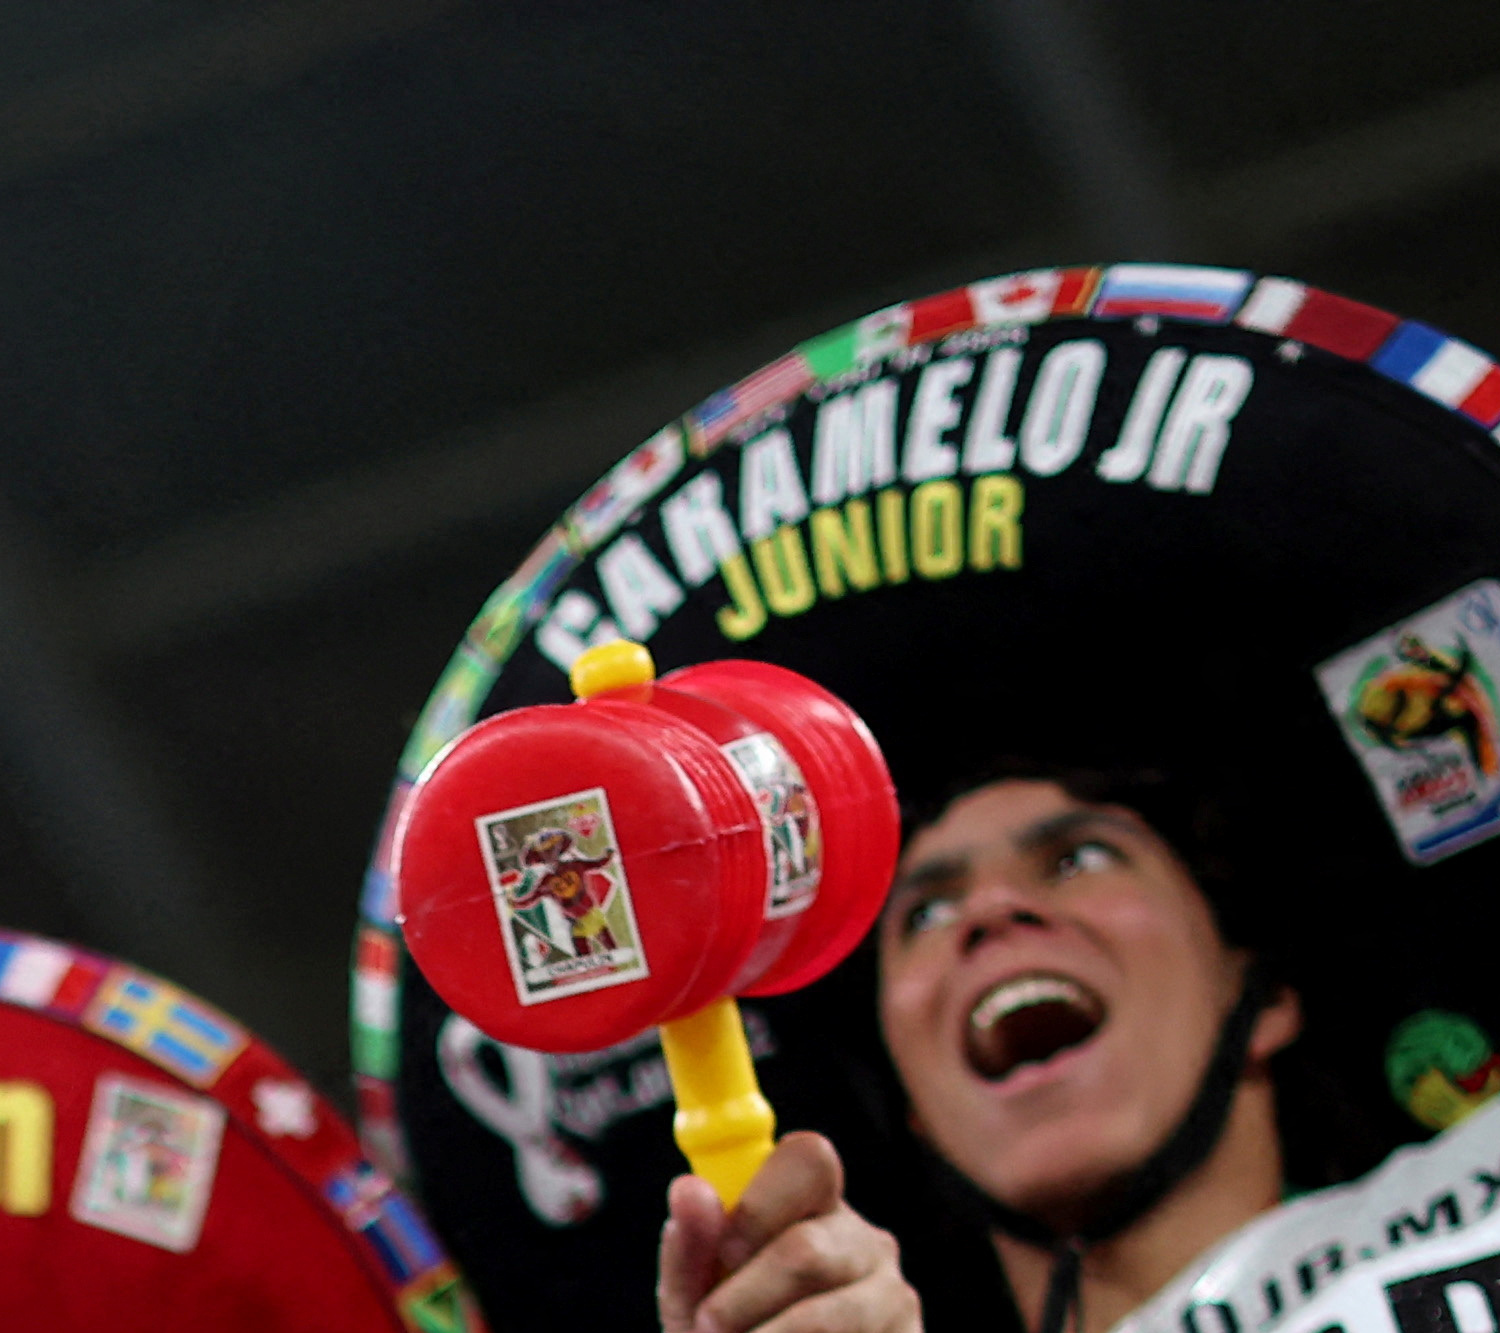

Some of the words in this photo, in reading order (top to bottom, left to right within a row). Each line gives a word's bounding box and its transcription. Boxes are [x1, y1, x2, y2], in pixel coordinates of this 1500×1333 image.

[535, 338, 1106, 674] CARAMELO
[1097, 346, 1254, 495] JR
[716, 475, 1024, 643] JUNIOR
